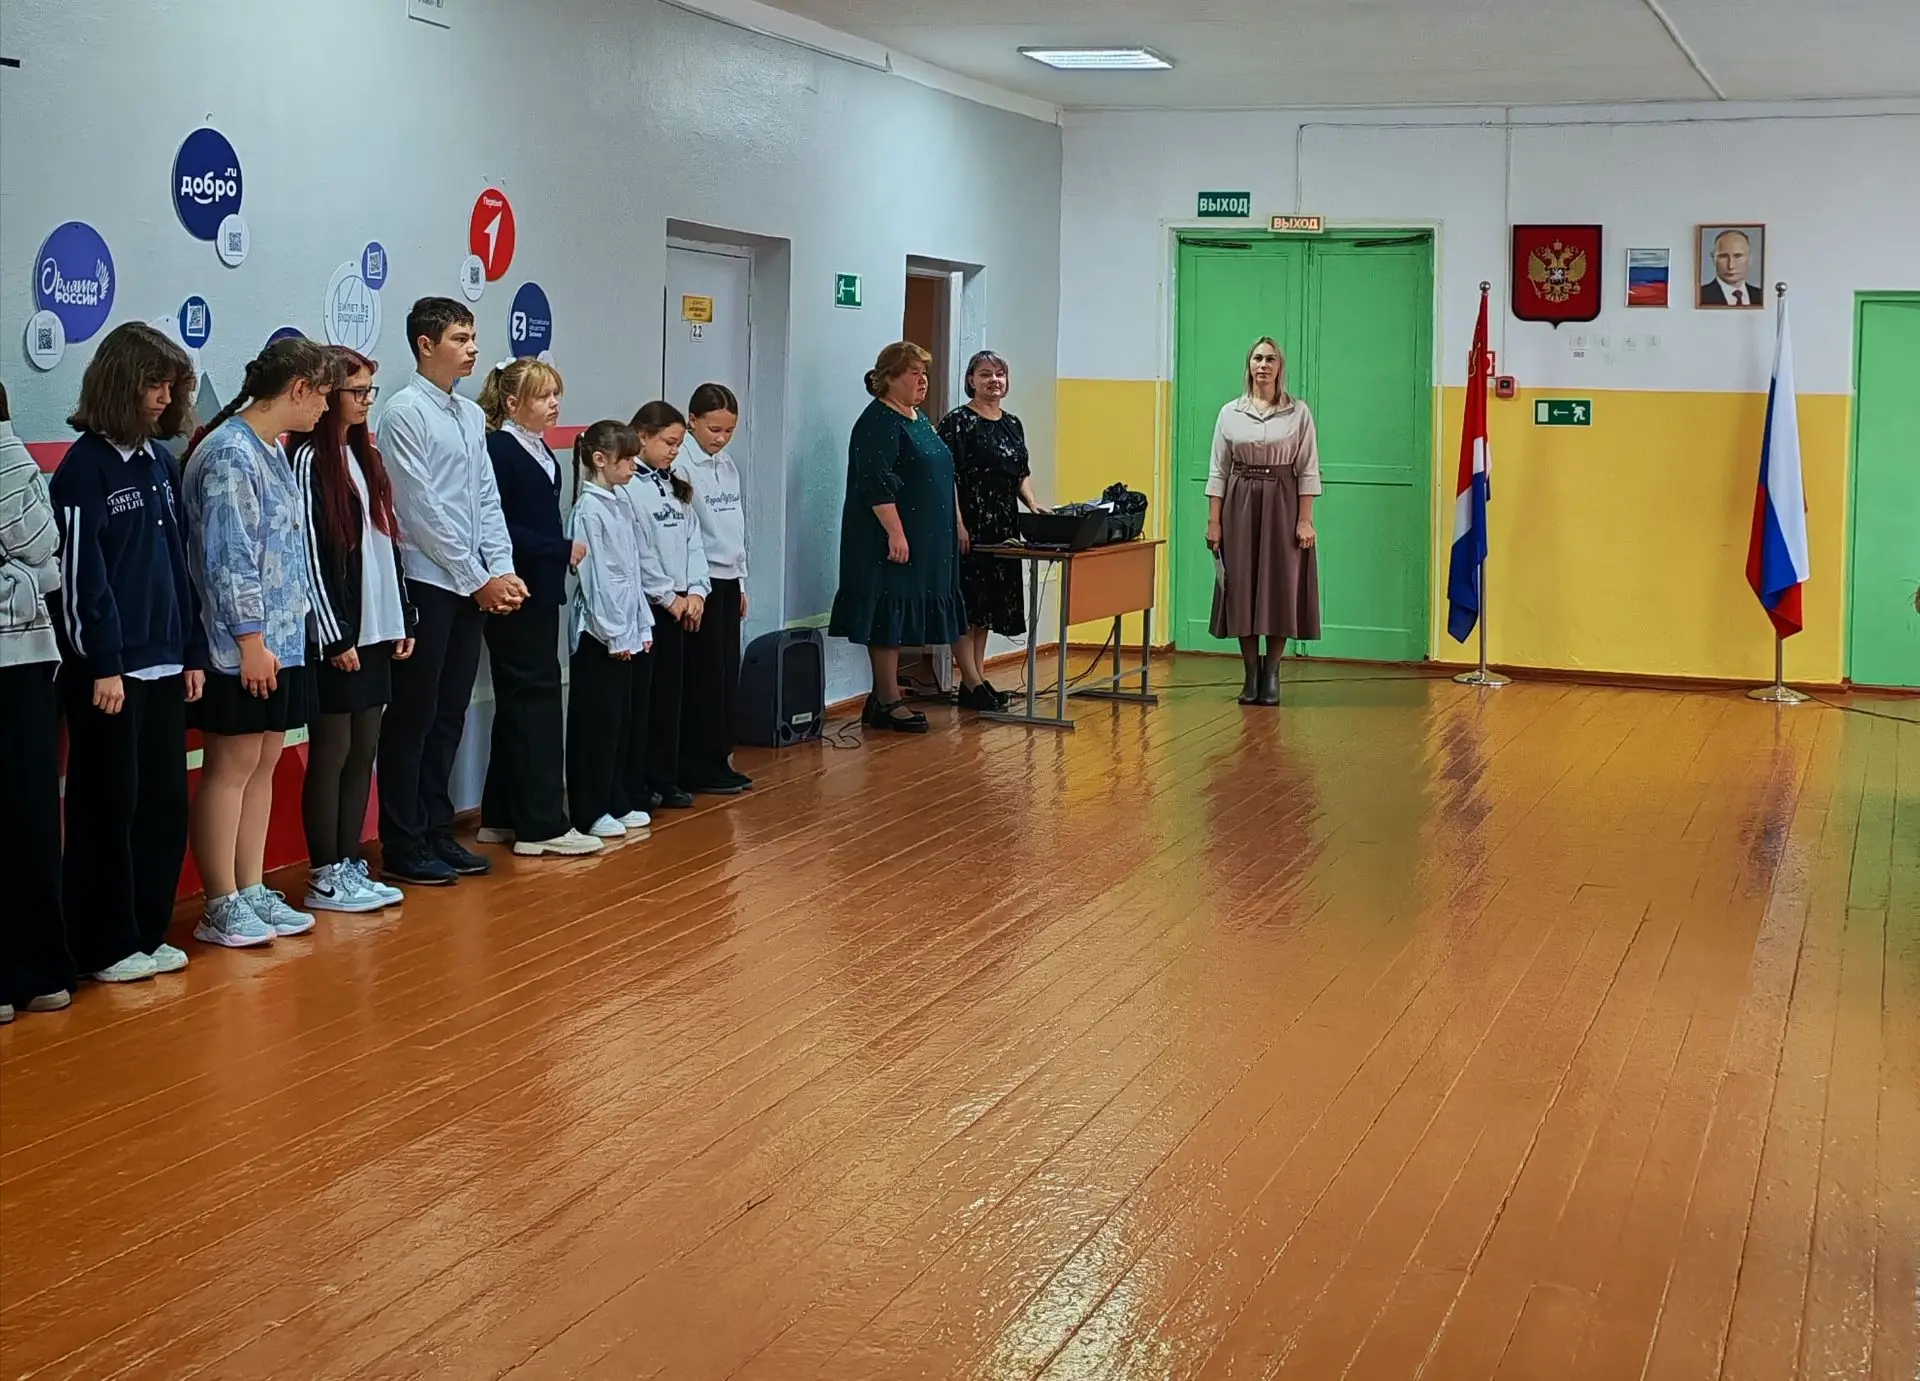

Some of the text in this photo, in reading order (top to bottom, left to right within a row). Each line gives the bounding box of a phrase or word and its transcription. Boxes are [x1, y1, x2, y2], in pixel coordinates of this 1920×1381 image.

[181, 171, 237, 202] добро
[1199, 198, 1248, 214] ВЫХОД
[1273, 217, 1319, 230] ВЫХОД
[56, 292, 98, 306] РОССИИ
